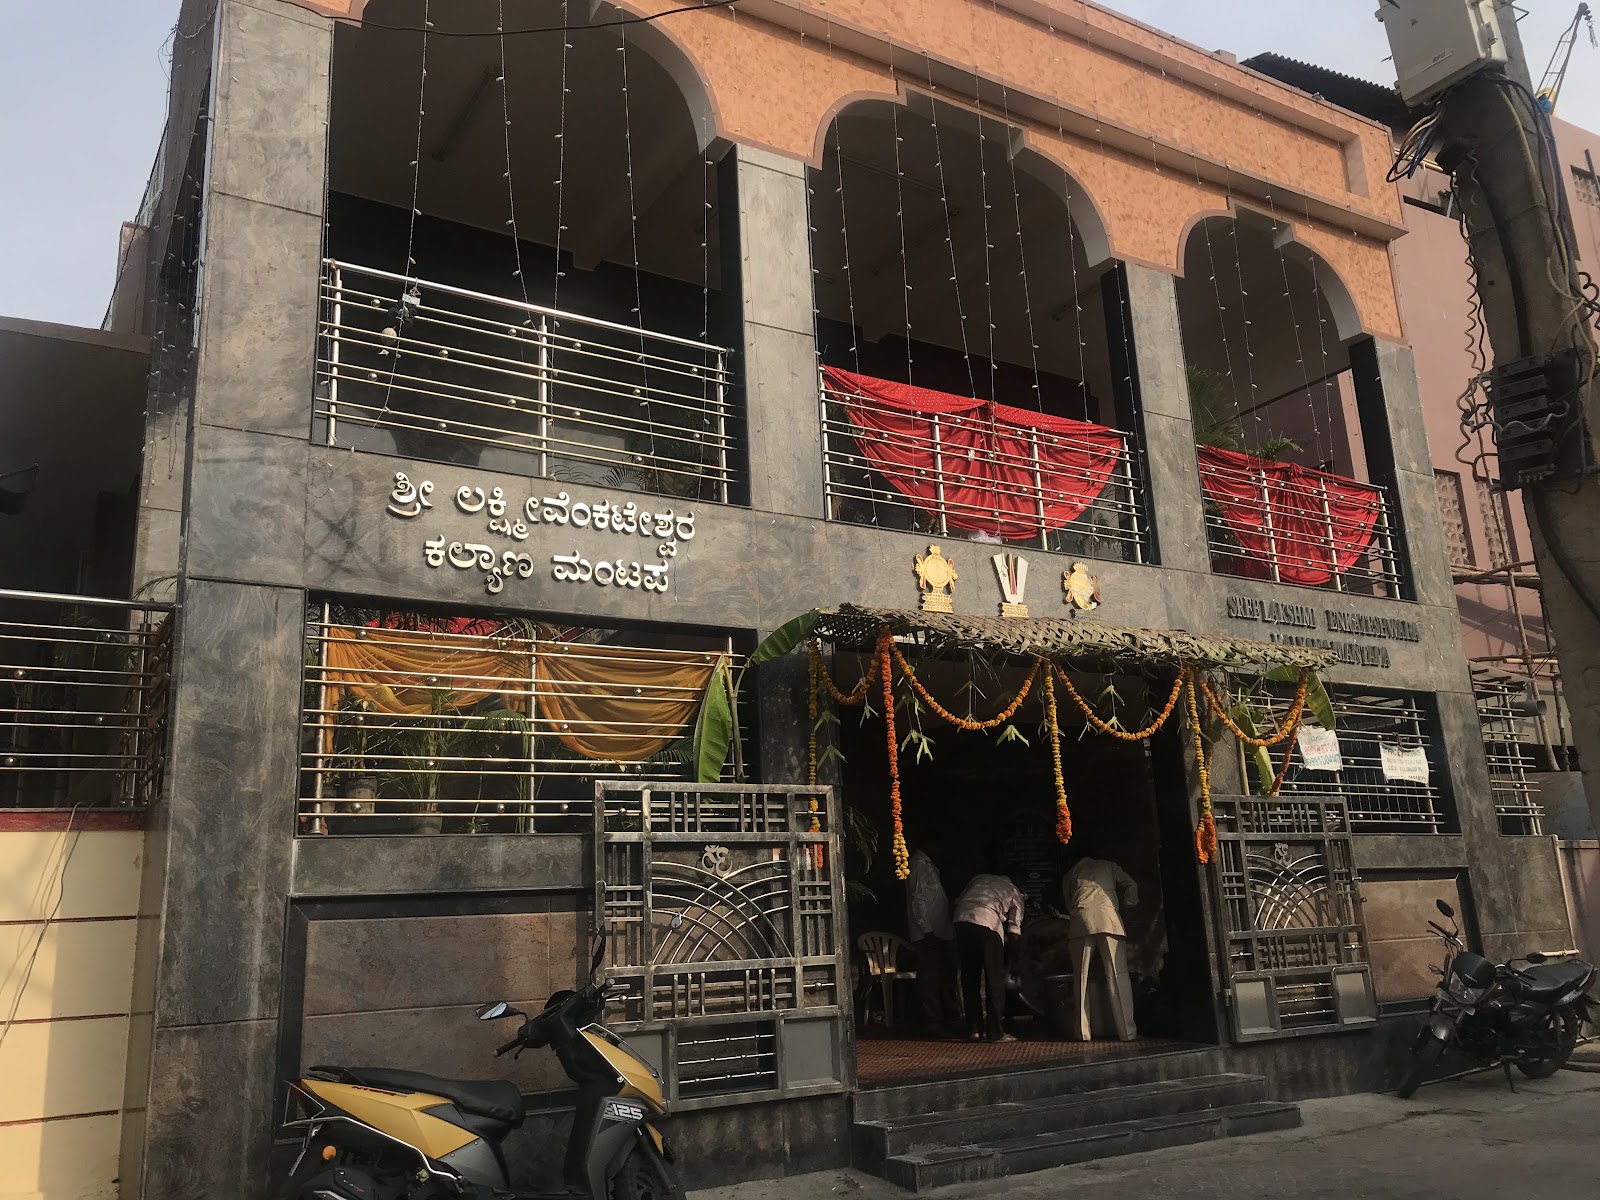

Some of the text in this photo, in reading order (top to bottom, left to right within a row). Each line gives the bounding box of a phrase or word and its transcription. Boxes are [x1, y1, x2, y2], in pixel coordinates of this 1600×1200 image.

[388, 471, 434, 516] ಶ್ರೀ
[424, 534, 670, 593] ಕಲ್ಯಾಣ ಮಂಟಪ
[612, 1103, 644, 1121] 125
